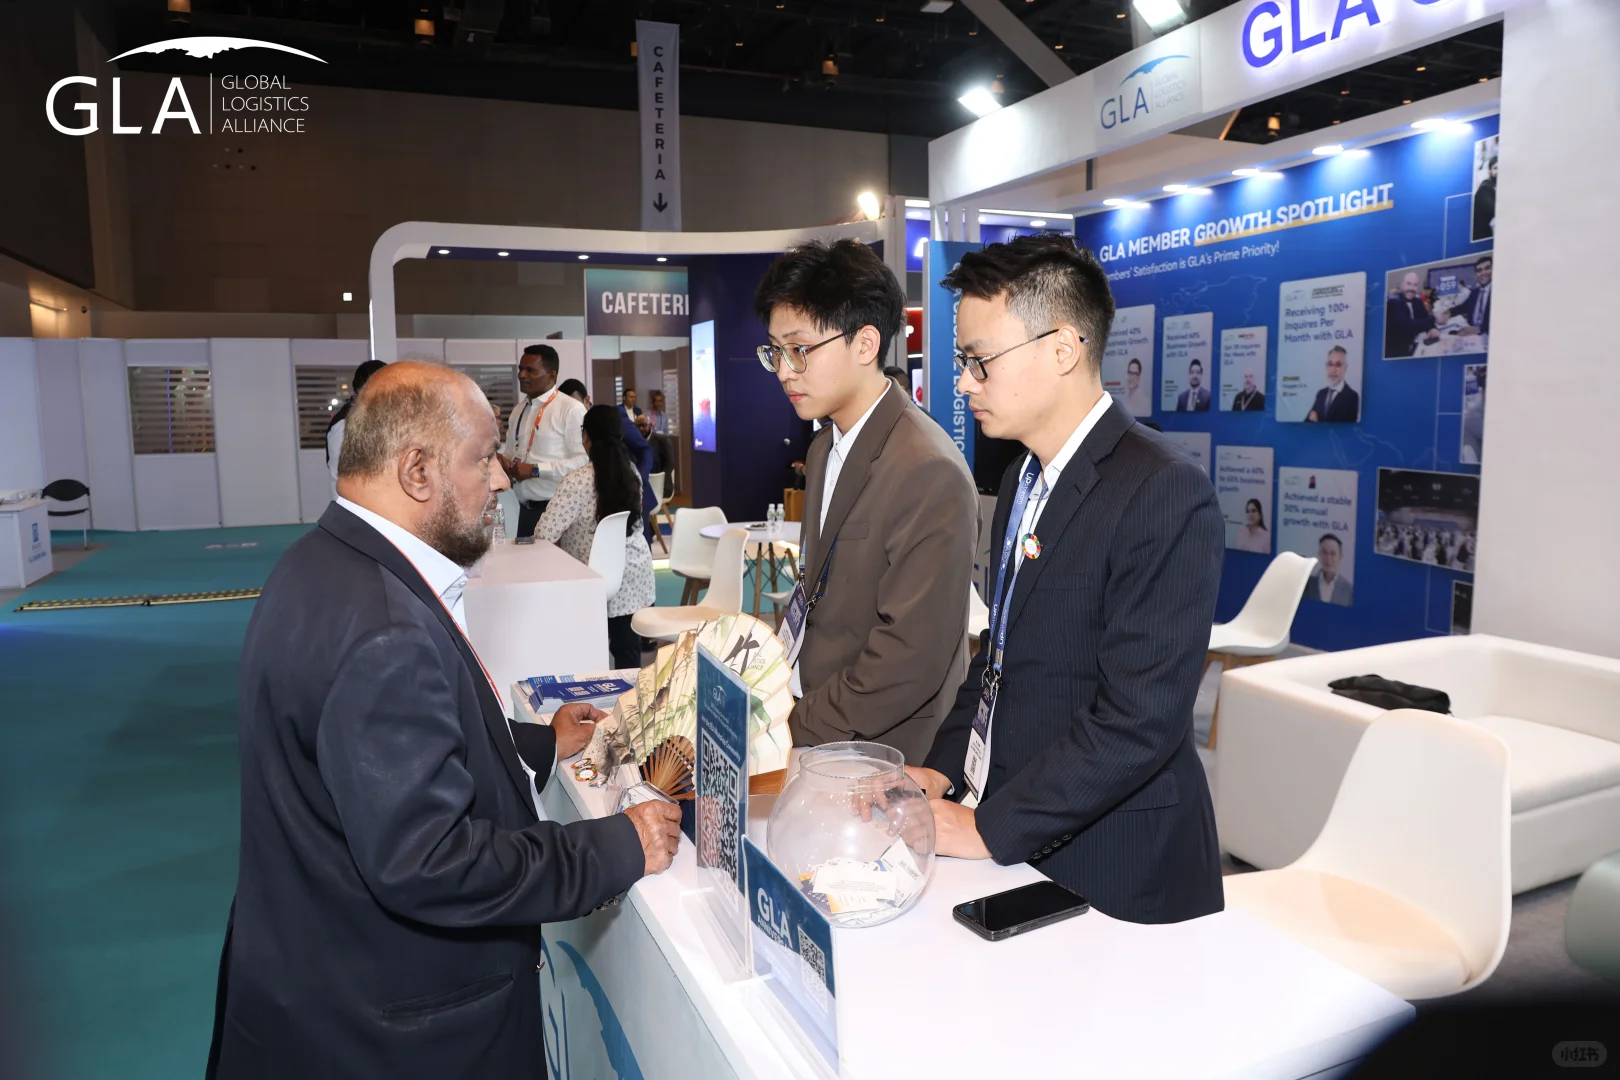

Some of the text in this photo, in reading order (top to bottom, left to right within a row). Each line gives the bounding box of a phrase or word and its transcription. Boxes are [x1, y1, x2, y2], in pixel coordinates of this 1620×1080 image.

[1242, 0, 1381, 68] GLA
[653, 46, 666, 181] CAFETERIA
[1100, 87, 1149, 129] GLA
[1100, 182, 1394, 263] GLA MEMBER GROWTH SPOTLIGHT
[1133, 260, 1178, 277] Satisfaction
[1179, 258, 1186, 269] is
[1187, 253, 1212, 268] GLA's
[1214, 249, 1240, 263] Prime
[1242, 240, 1280, 258] Priority!
[602, 291, 690, 316] CAFETERI
[1285, 302, 1350, 317] Receiving 100+
[1284, 329, 1354, 342] Month with GLA
[1320, 318, 1335, 327] Per
[952, 376, 967, 455] LOGISTIC
[1284, 492, 1319, 504] Achieved
[1326, 495, 1353, 506] stable
[1283, 517, 1349, 531] growth with GLA
[758, 887, 793, 950] GLA
